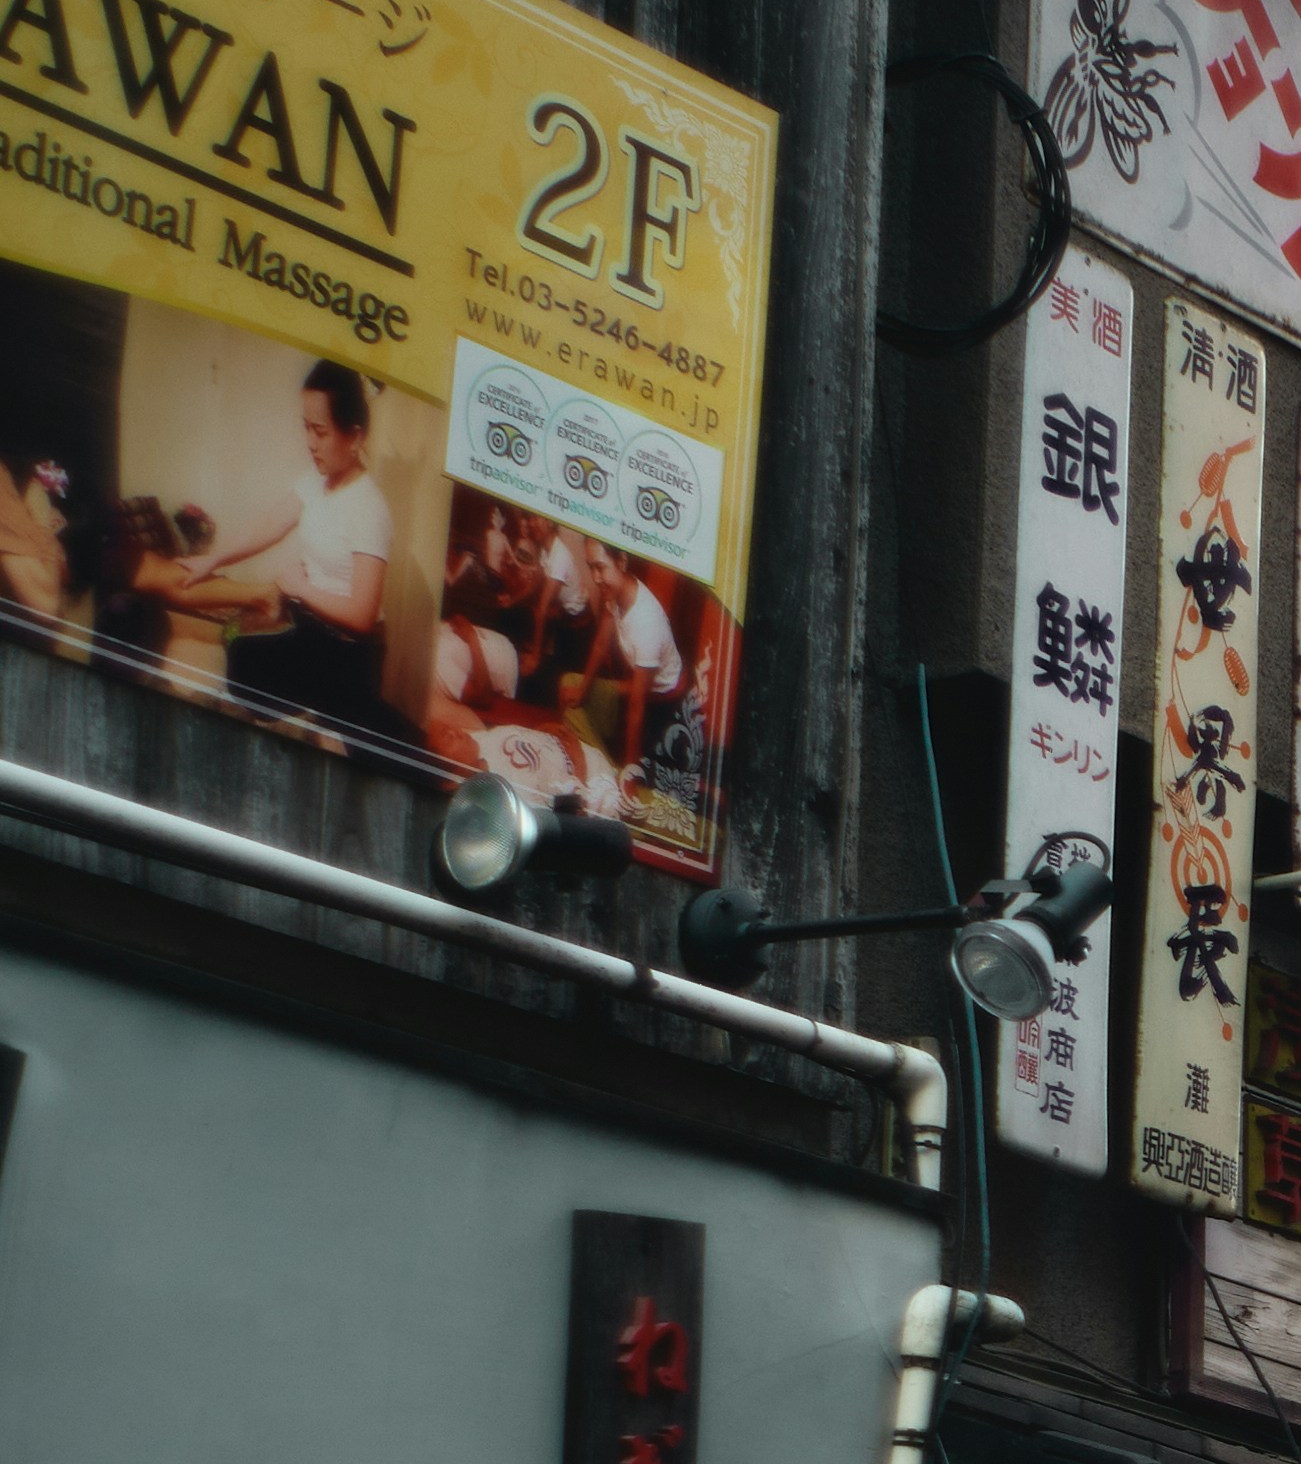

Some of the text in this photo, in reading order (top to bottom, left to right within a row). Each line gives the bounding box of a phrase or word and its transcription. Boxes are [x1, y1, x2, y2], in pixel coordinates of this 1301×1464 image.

[518, 92, 701, 310] 2F
[218, 219, 410, 344] Massage
[1048, 276, 1124, 359] 美酒
[465, 298, 719, 433] www.erawan.jp
[1180, 318, 1258, 414] 清酒
[478, 393, 545, 428] EXCELLENCE
[557, 426, 619, 462] EXCELLENCE
[470, 456, 538, 495] tripadvisor
[628, 458, 694, 495] EXCELLENCE
[548, 489, 615, 526] tripadvisor
[621, 519, 688, 559] tripadvisor
[1031, 722, 1110, 782] ギンリン
